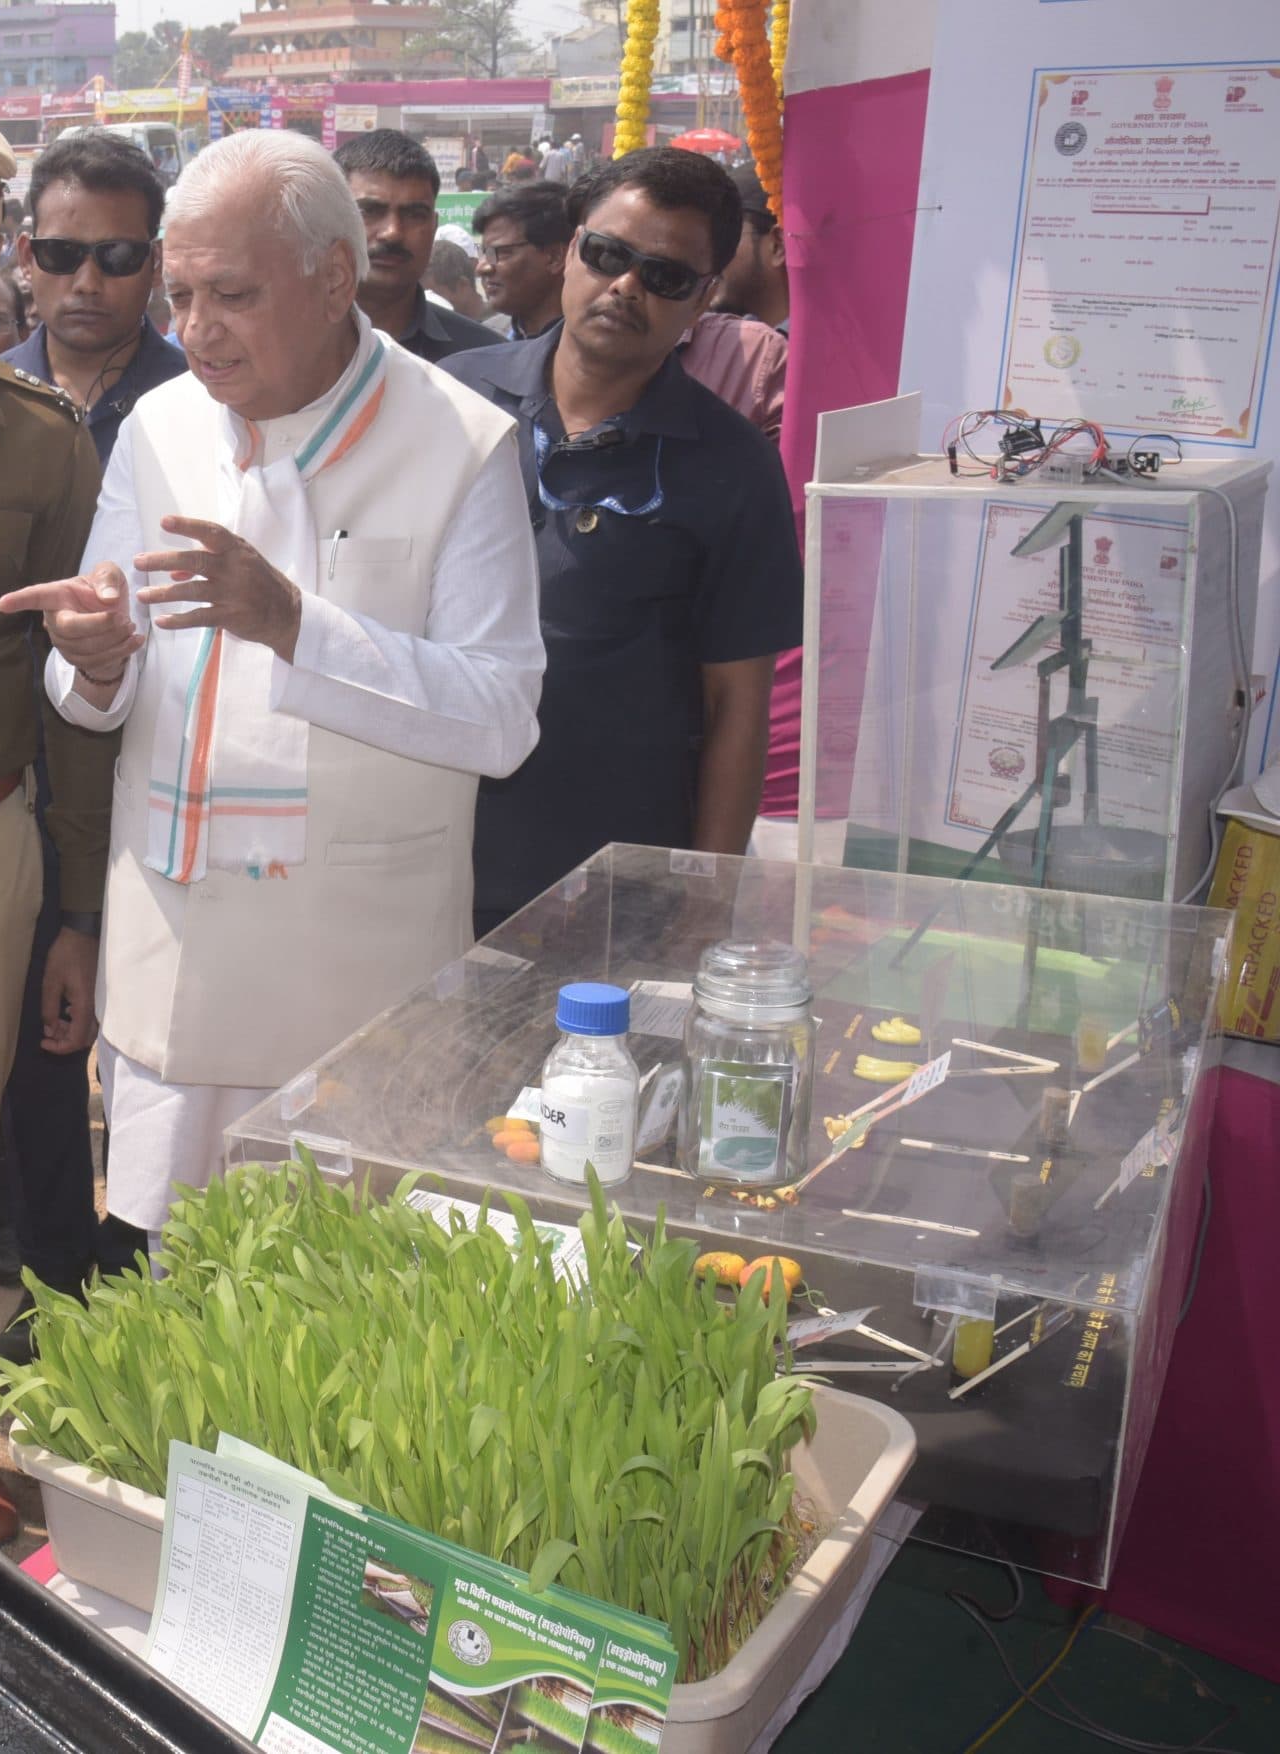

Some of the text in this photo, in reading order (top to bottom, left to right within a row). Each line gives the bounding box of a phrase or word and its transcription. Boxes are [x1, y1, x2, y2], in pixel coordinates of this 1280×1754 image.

[1111, 121, 1168, 129] GOVERNMENT
[1093, 147, 1220, 156] Geographical Indication Registry
[1121, 579, 1144, 588] INDIA
[1239, 890, 1277, 990] REPACKED
[454, 1579, 468, 1593] मृदा
[469, 1584, 490, 1601] विहीन
[491, 1595, 537, 1623] फसलोत्पादन
